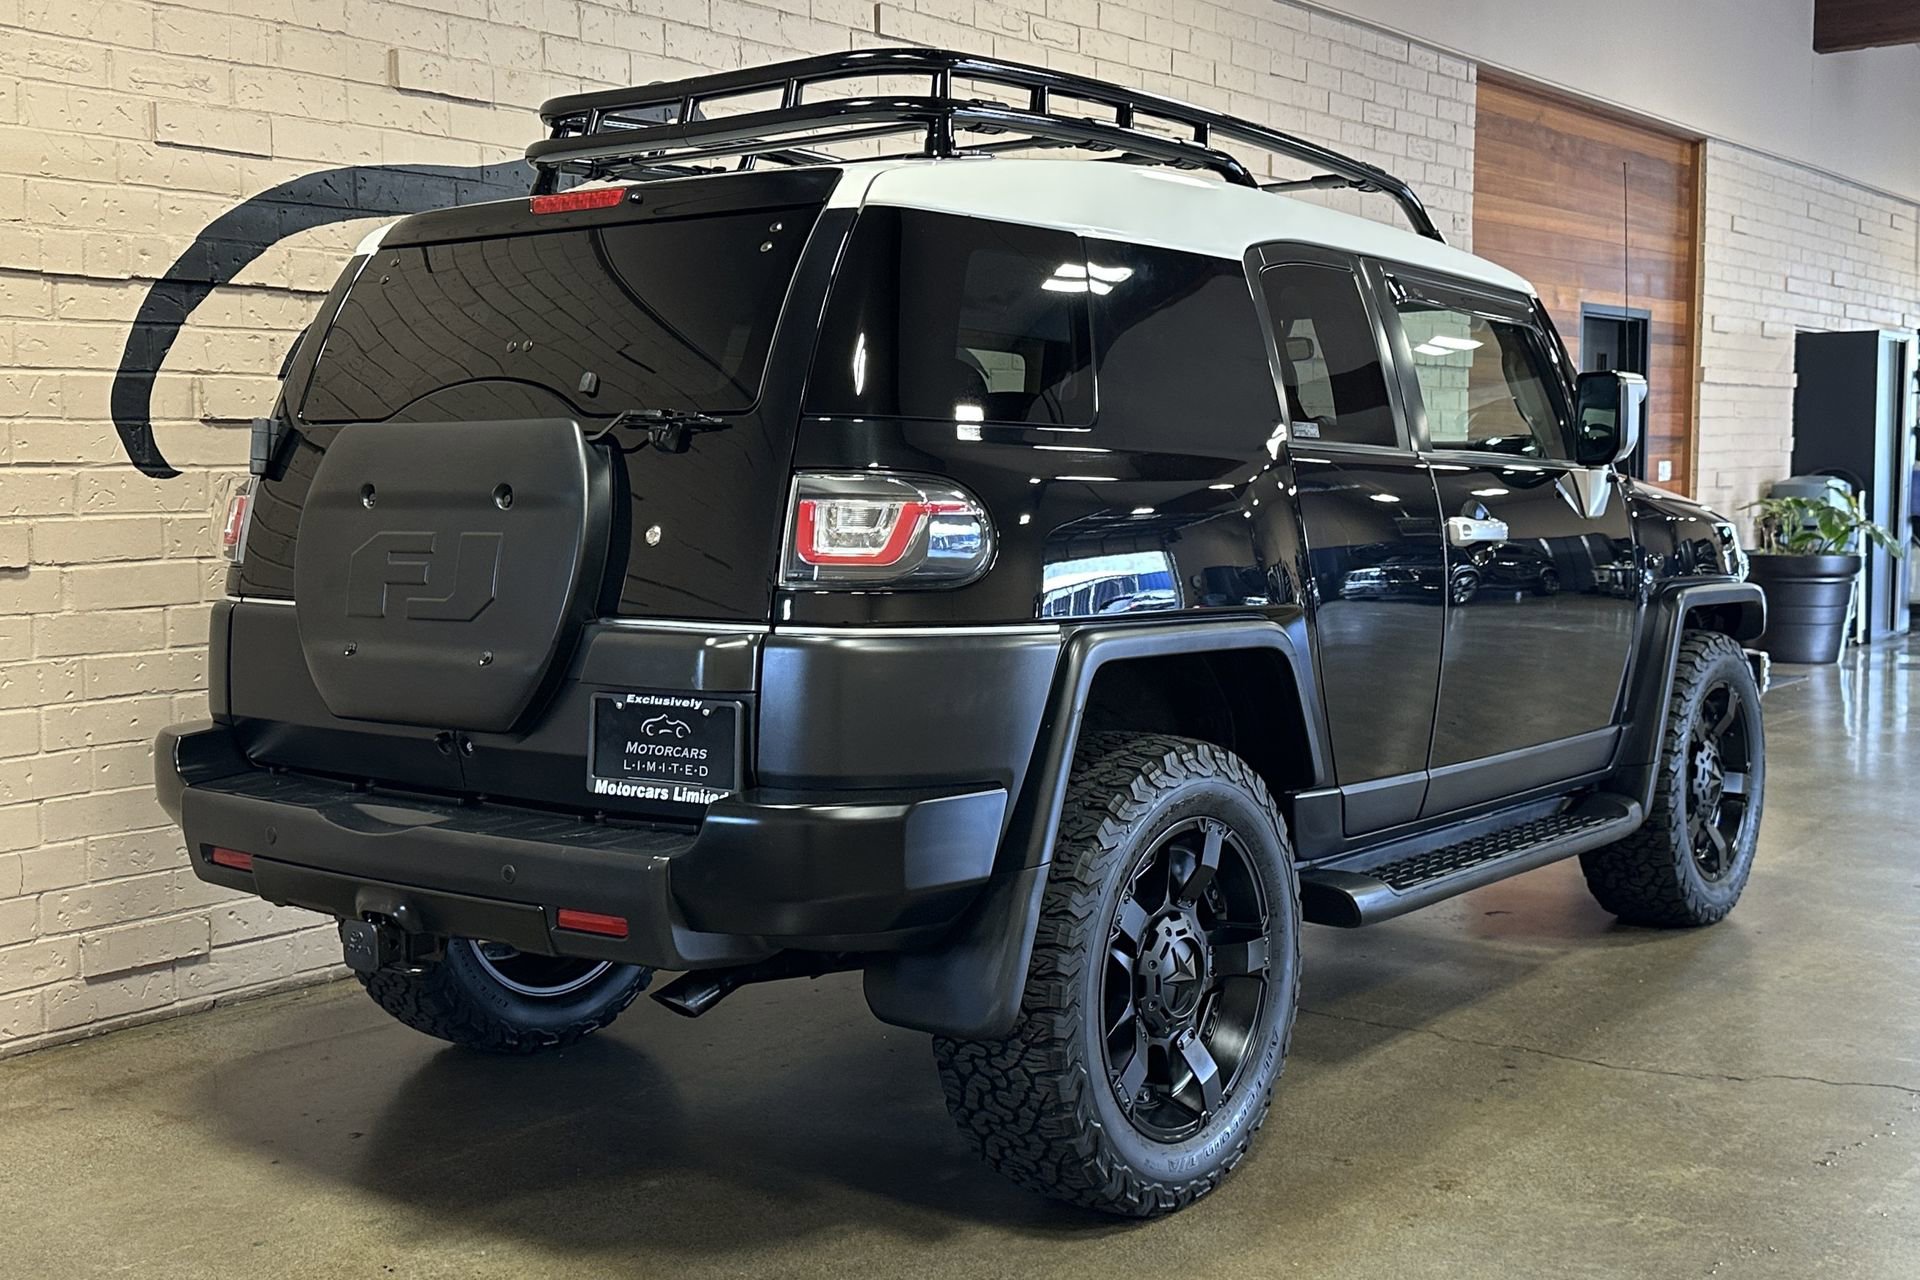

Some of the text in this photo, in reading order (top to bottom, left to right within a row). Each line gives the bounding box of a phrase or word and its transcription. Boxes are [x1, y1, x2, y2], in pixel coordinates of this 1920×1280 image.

[346, 531, 503, 622] FJ
[626, 694, 703, 710] Exclusively
[625, 741, 708, 759] MOTORCARS
[594, 779, 669, 800] Motorcars
